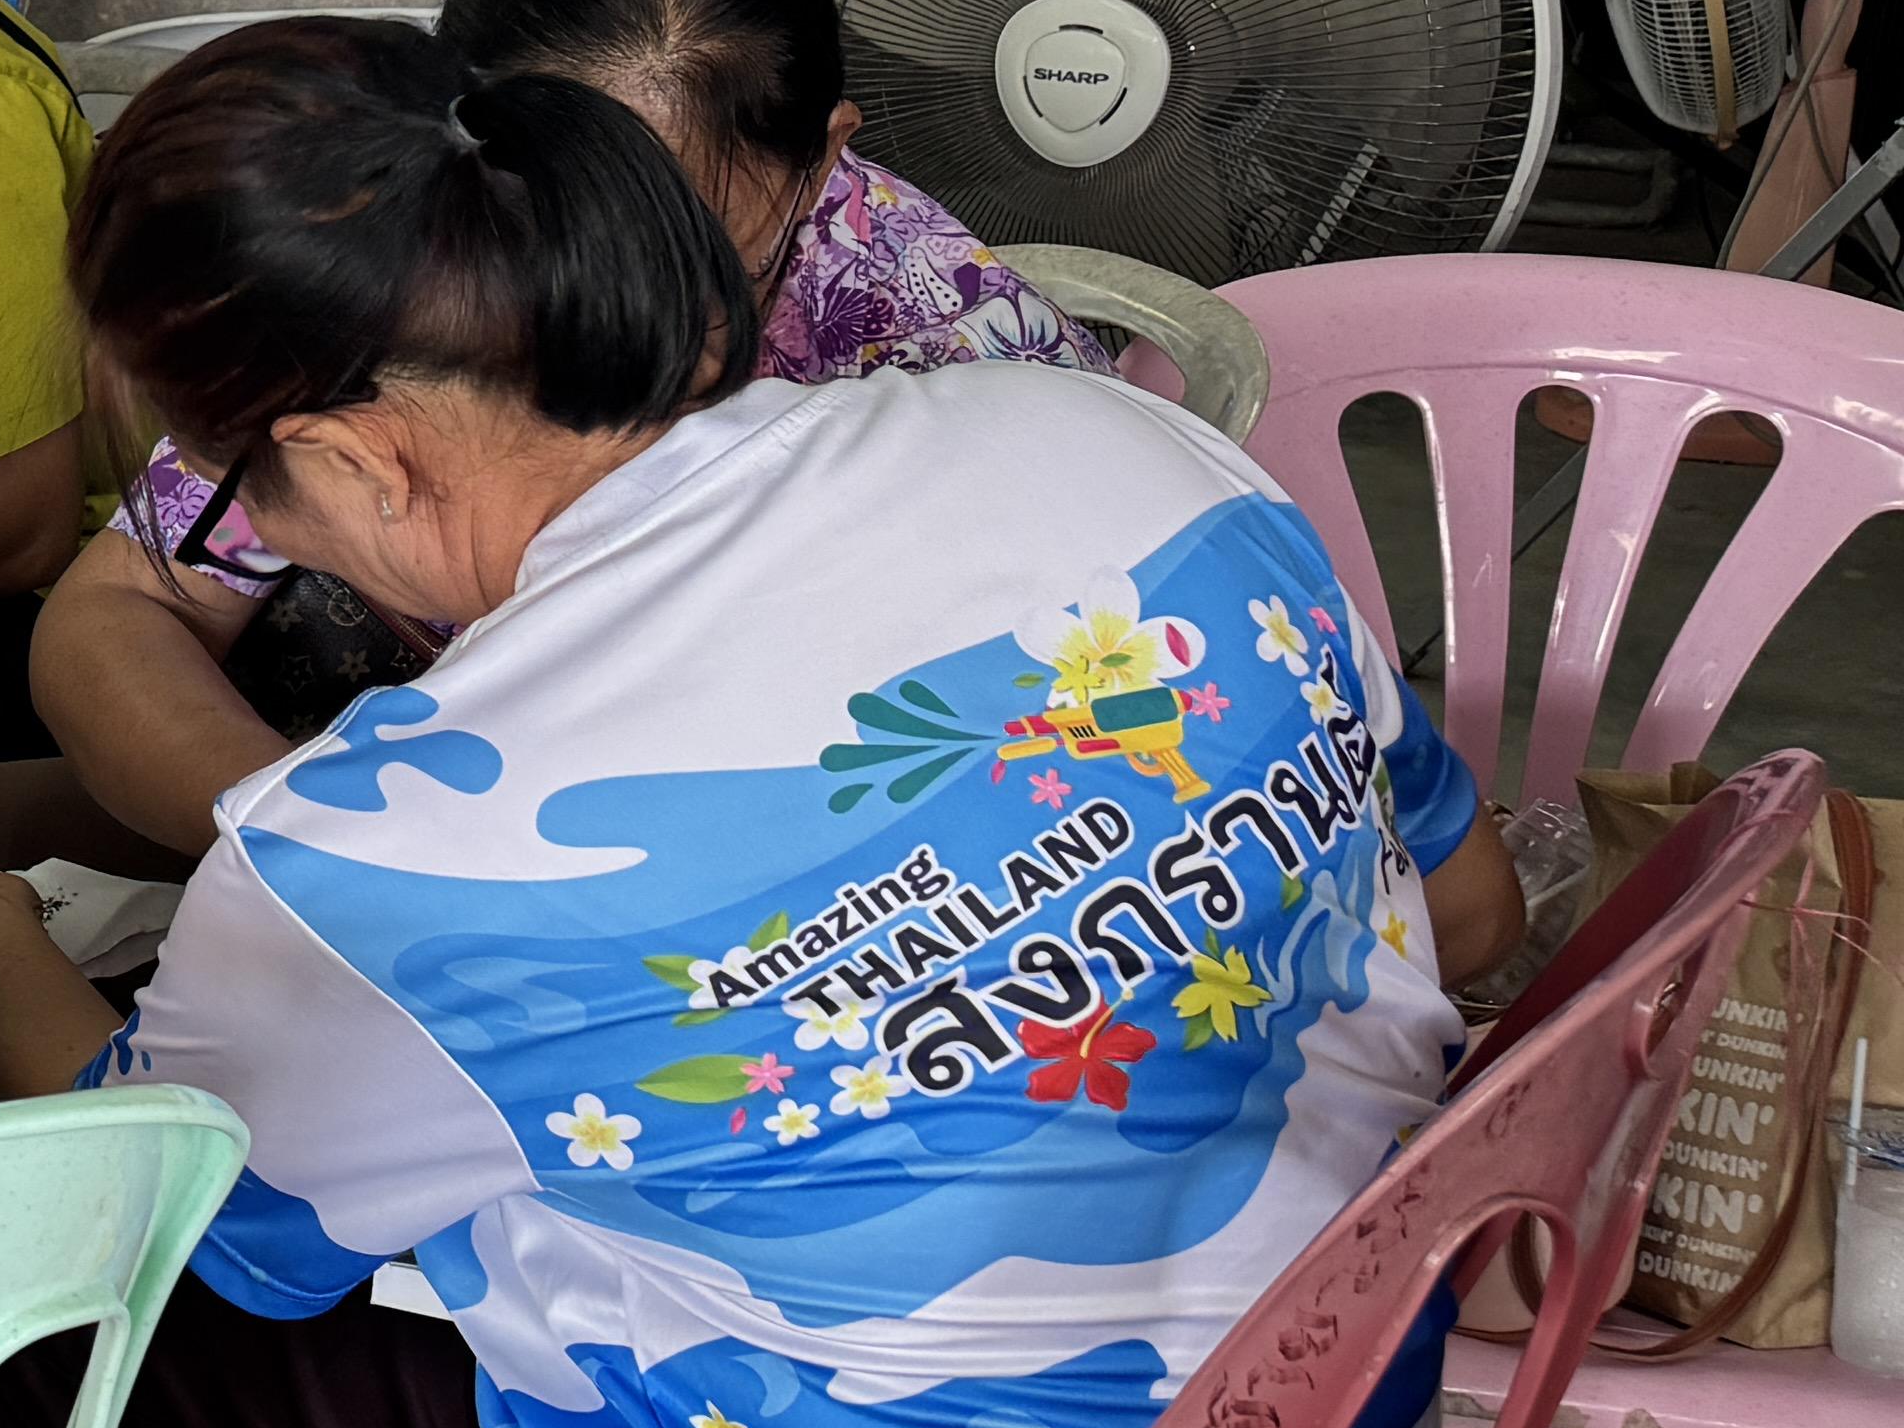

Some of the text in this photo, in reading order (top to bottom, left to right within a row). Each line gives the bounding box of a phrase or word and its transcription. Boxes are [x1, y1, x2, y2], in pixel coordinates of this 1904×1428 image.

[1033, 68, 1110, 84] SHARP
[704, 848, 953, 1009] Amazing
[789, 800, 1132, 1018] THAILAND
